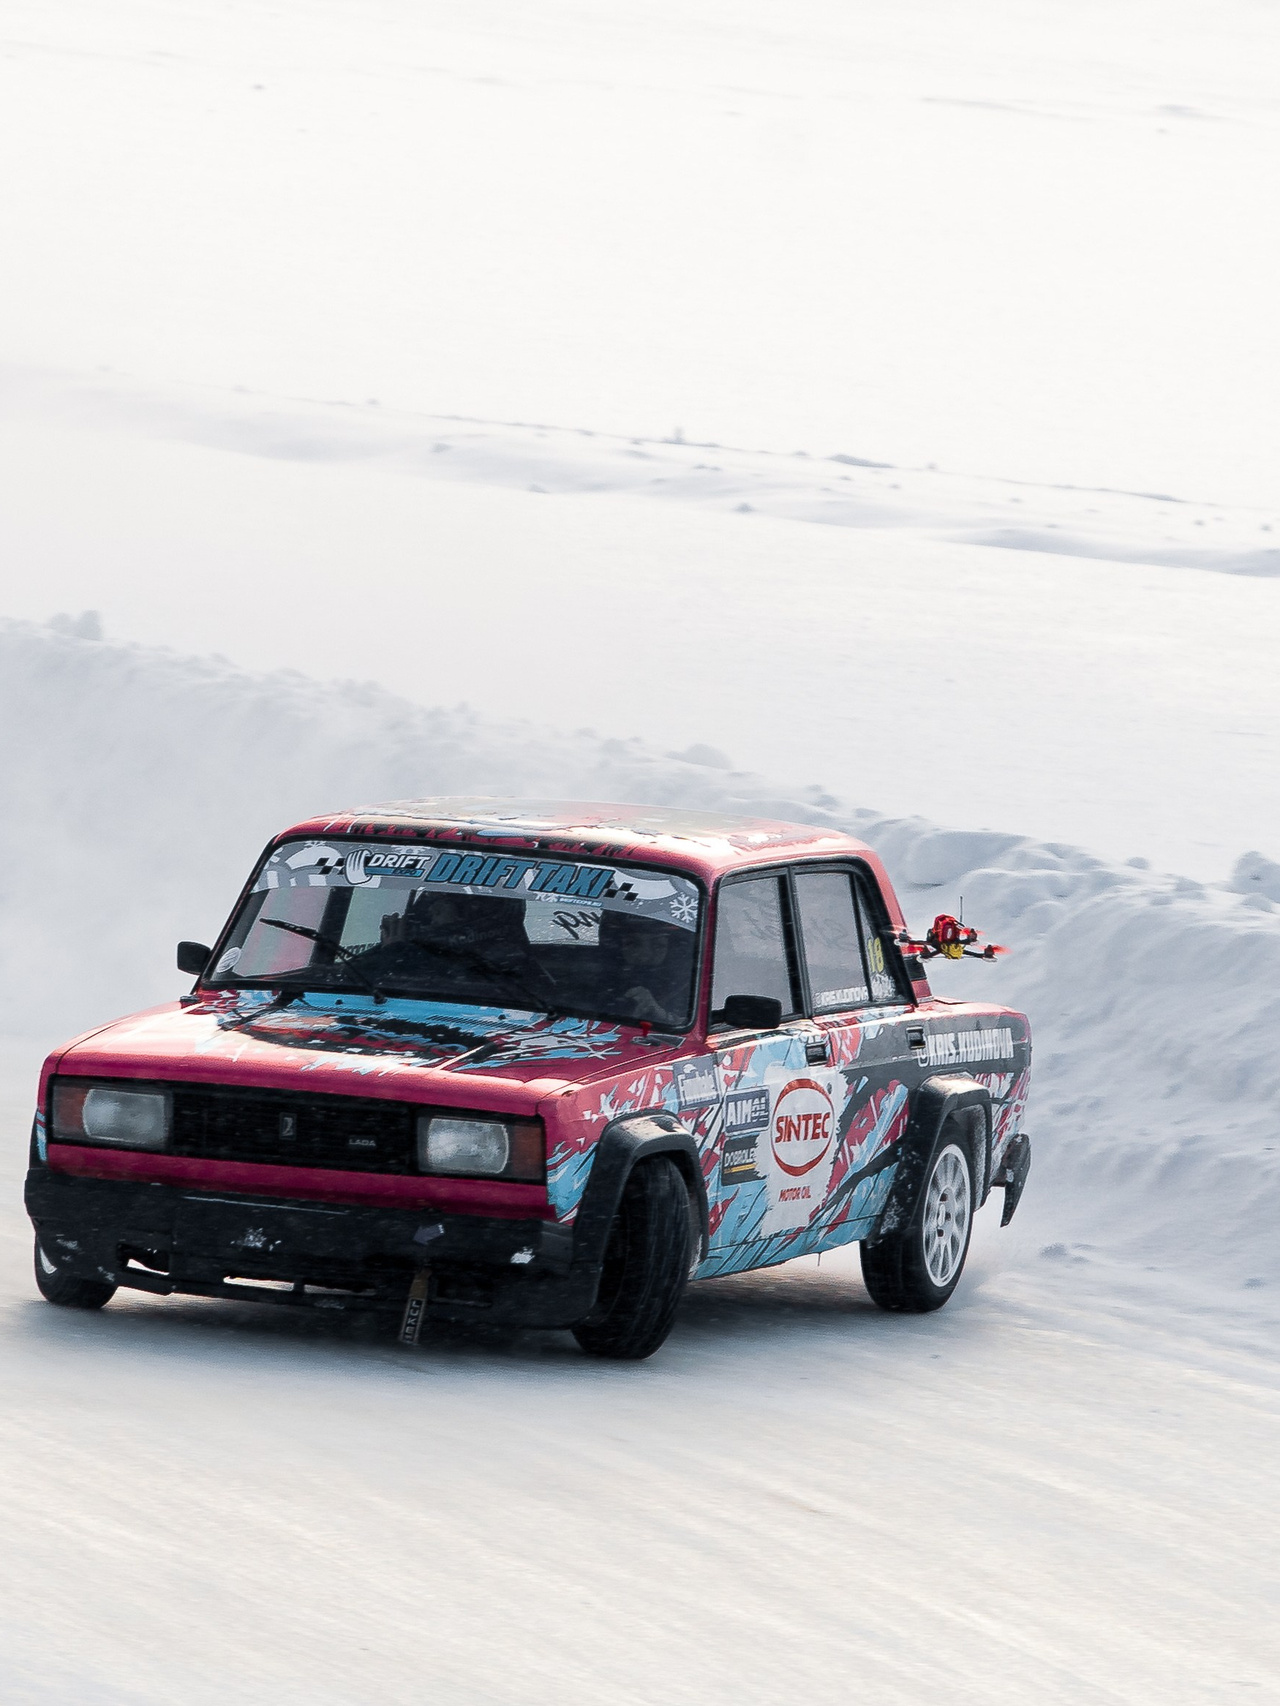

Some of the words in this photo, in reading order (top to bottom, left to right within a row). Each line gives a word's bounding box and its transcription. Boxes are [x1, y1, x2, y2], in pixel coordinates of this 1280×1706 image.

[369, 853, 431, 869] DRIFT
[424, 852, 537, 889] DRIFT
[528, 861, 616, 899] TAXI
[725, 1098, 754, 1127] AIM
[775, 1111, 831, 1143] SINTEC
[778, 1186, 801, 1202] MOTOR
